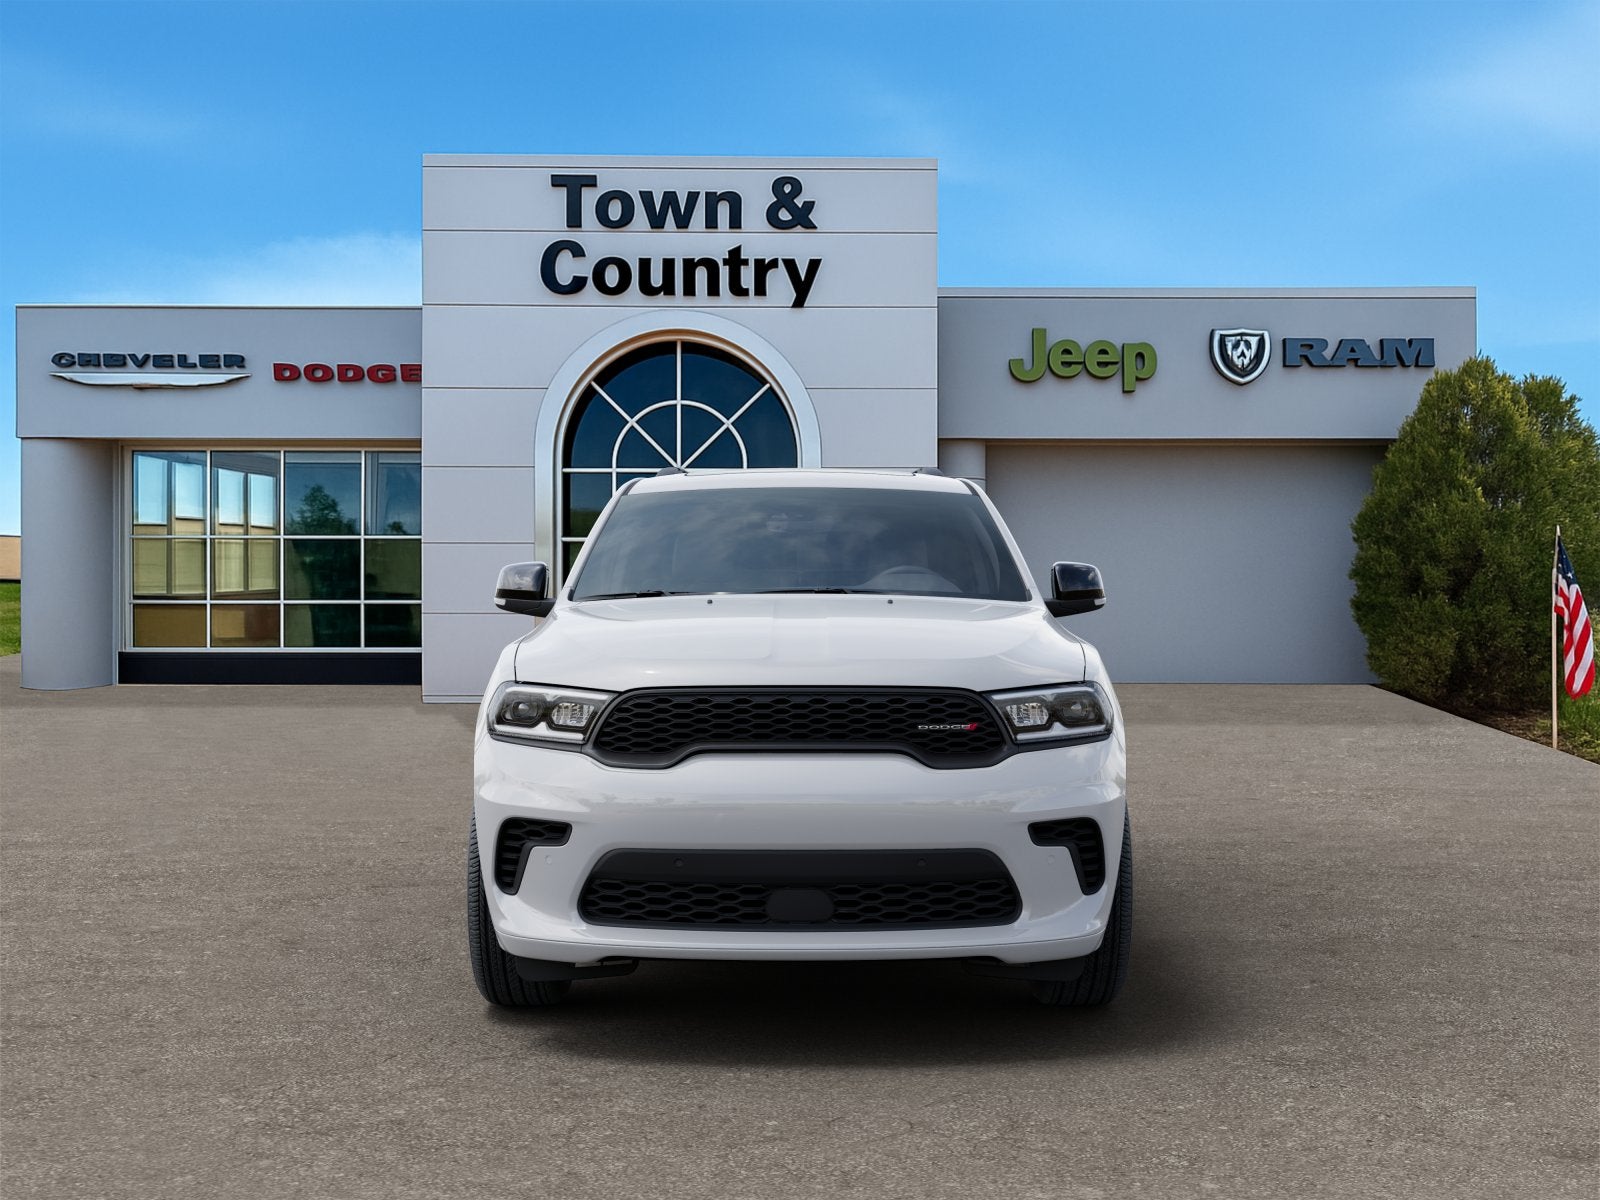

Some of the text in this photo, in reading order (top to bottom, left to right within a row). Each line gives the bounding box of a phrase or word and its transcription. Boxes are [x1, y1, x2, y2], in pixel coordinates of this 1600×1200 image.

[551, 174, 818, 231] Town &
[540, 239, 823, 308] Country
[273, 363, 422, 383] DODGE
[1009, 328, 1157, 393] Jeep
[1282, 337, 1436, 368] RAM
